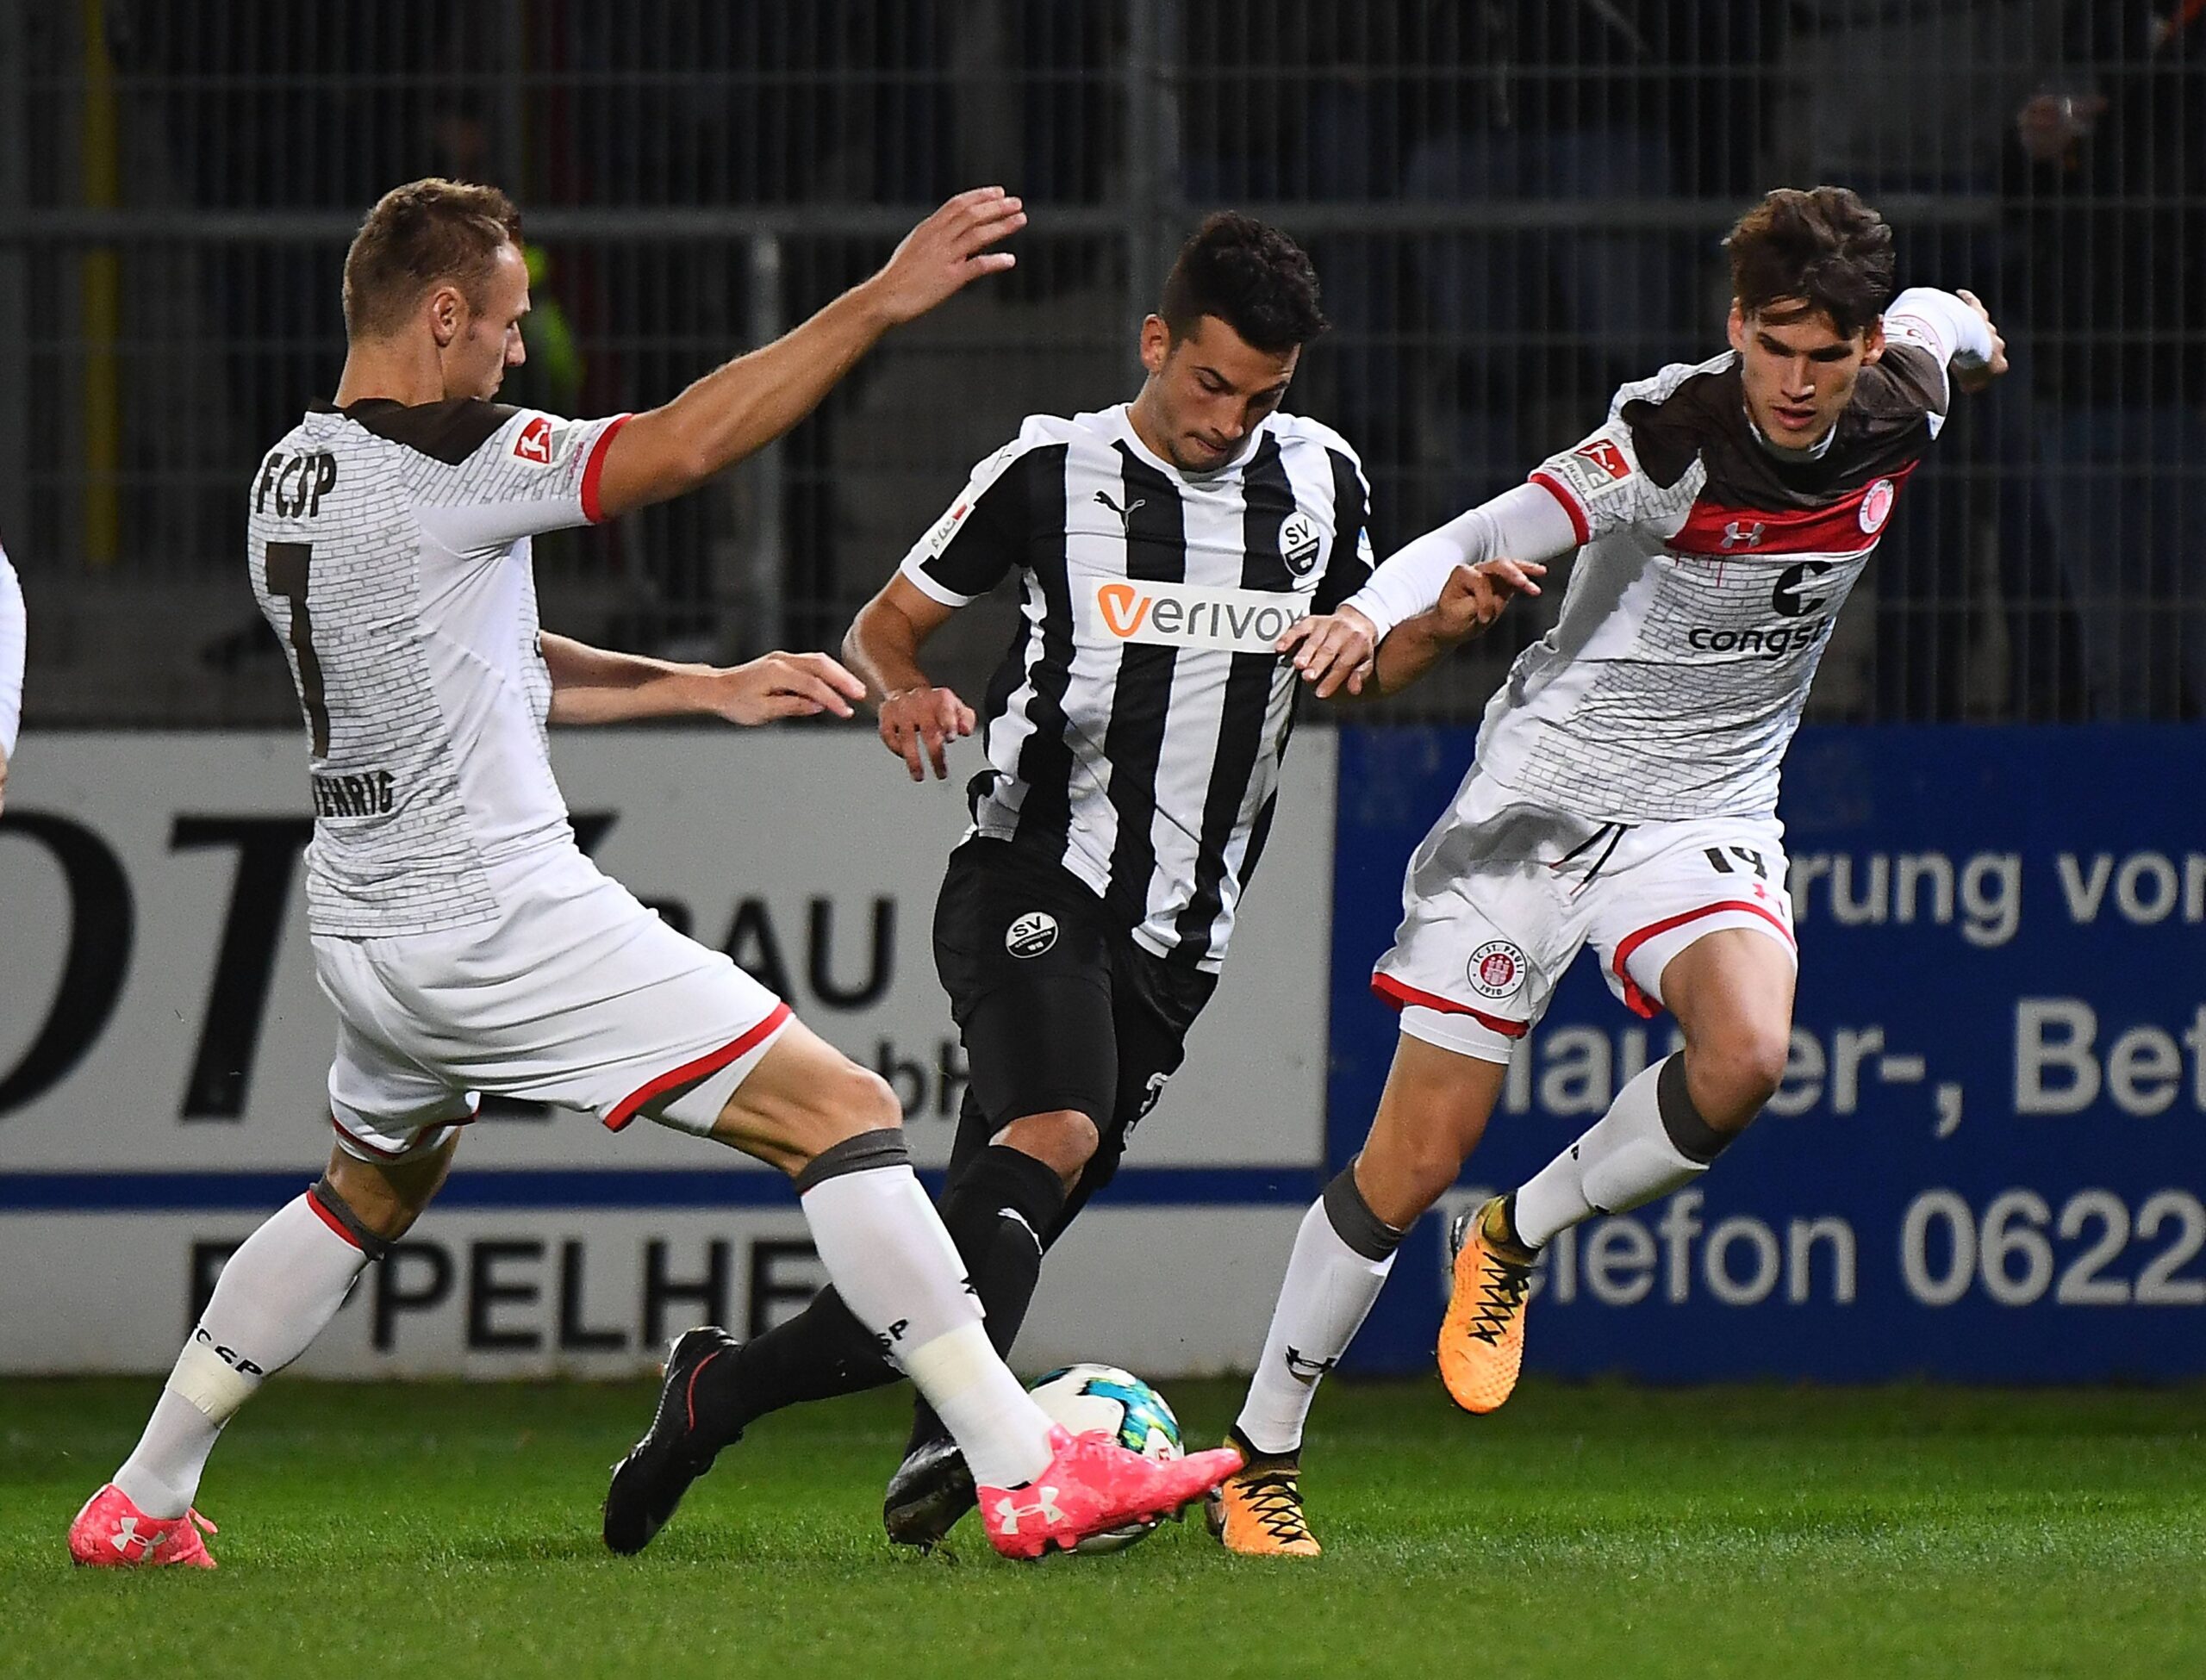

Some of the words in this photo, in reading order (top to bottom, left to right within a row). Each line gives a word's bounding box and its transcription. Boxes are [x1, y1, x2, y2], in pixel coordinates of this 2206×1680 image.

[256, 452, 337, 518] FCSP
[1285, 519, 1309, 545] SV
[1013, 915, 1042, 937] SV
[1480, 984, 1503, 996] 1910
[1902, 1188, 2206, 1305] 0622
